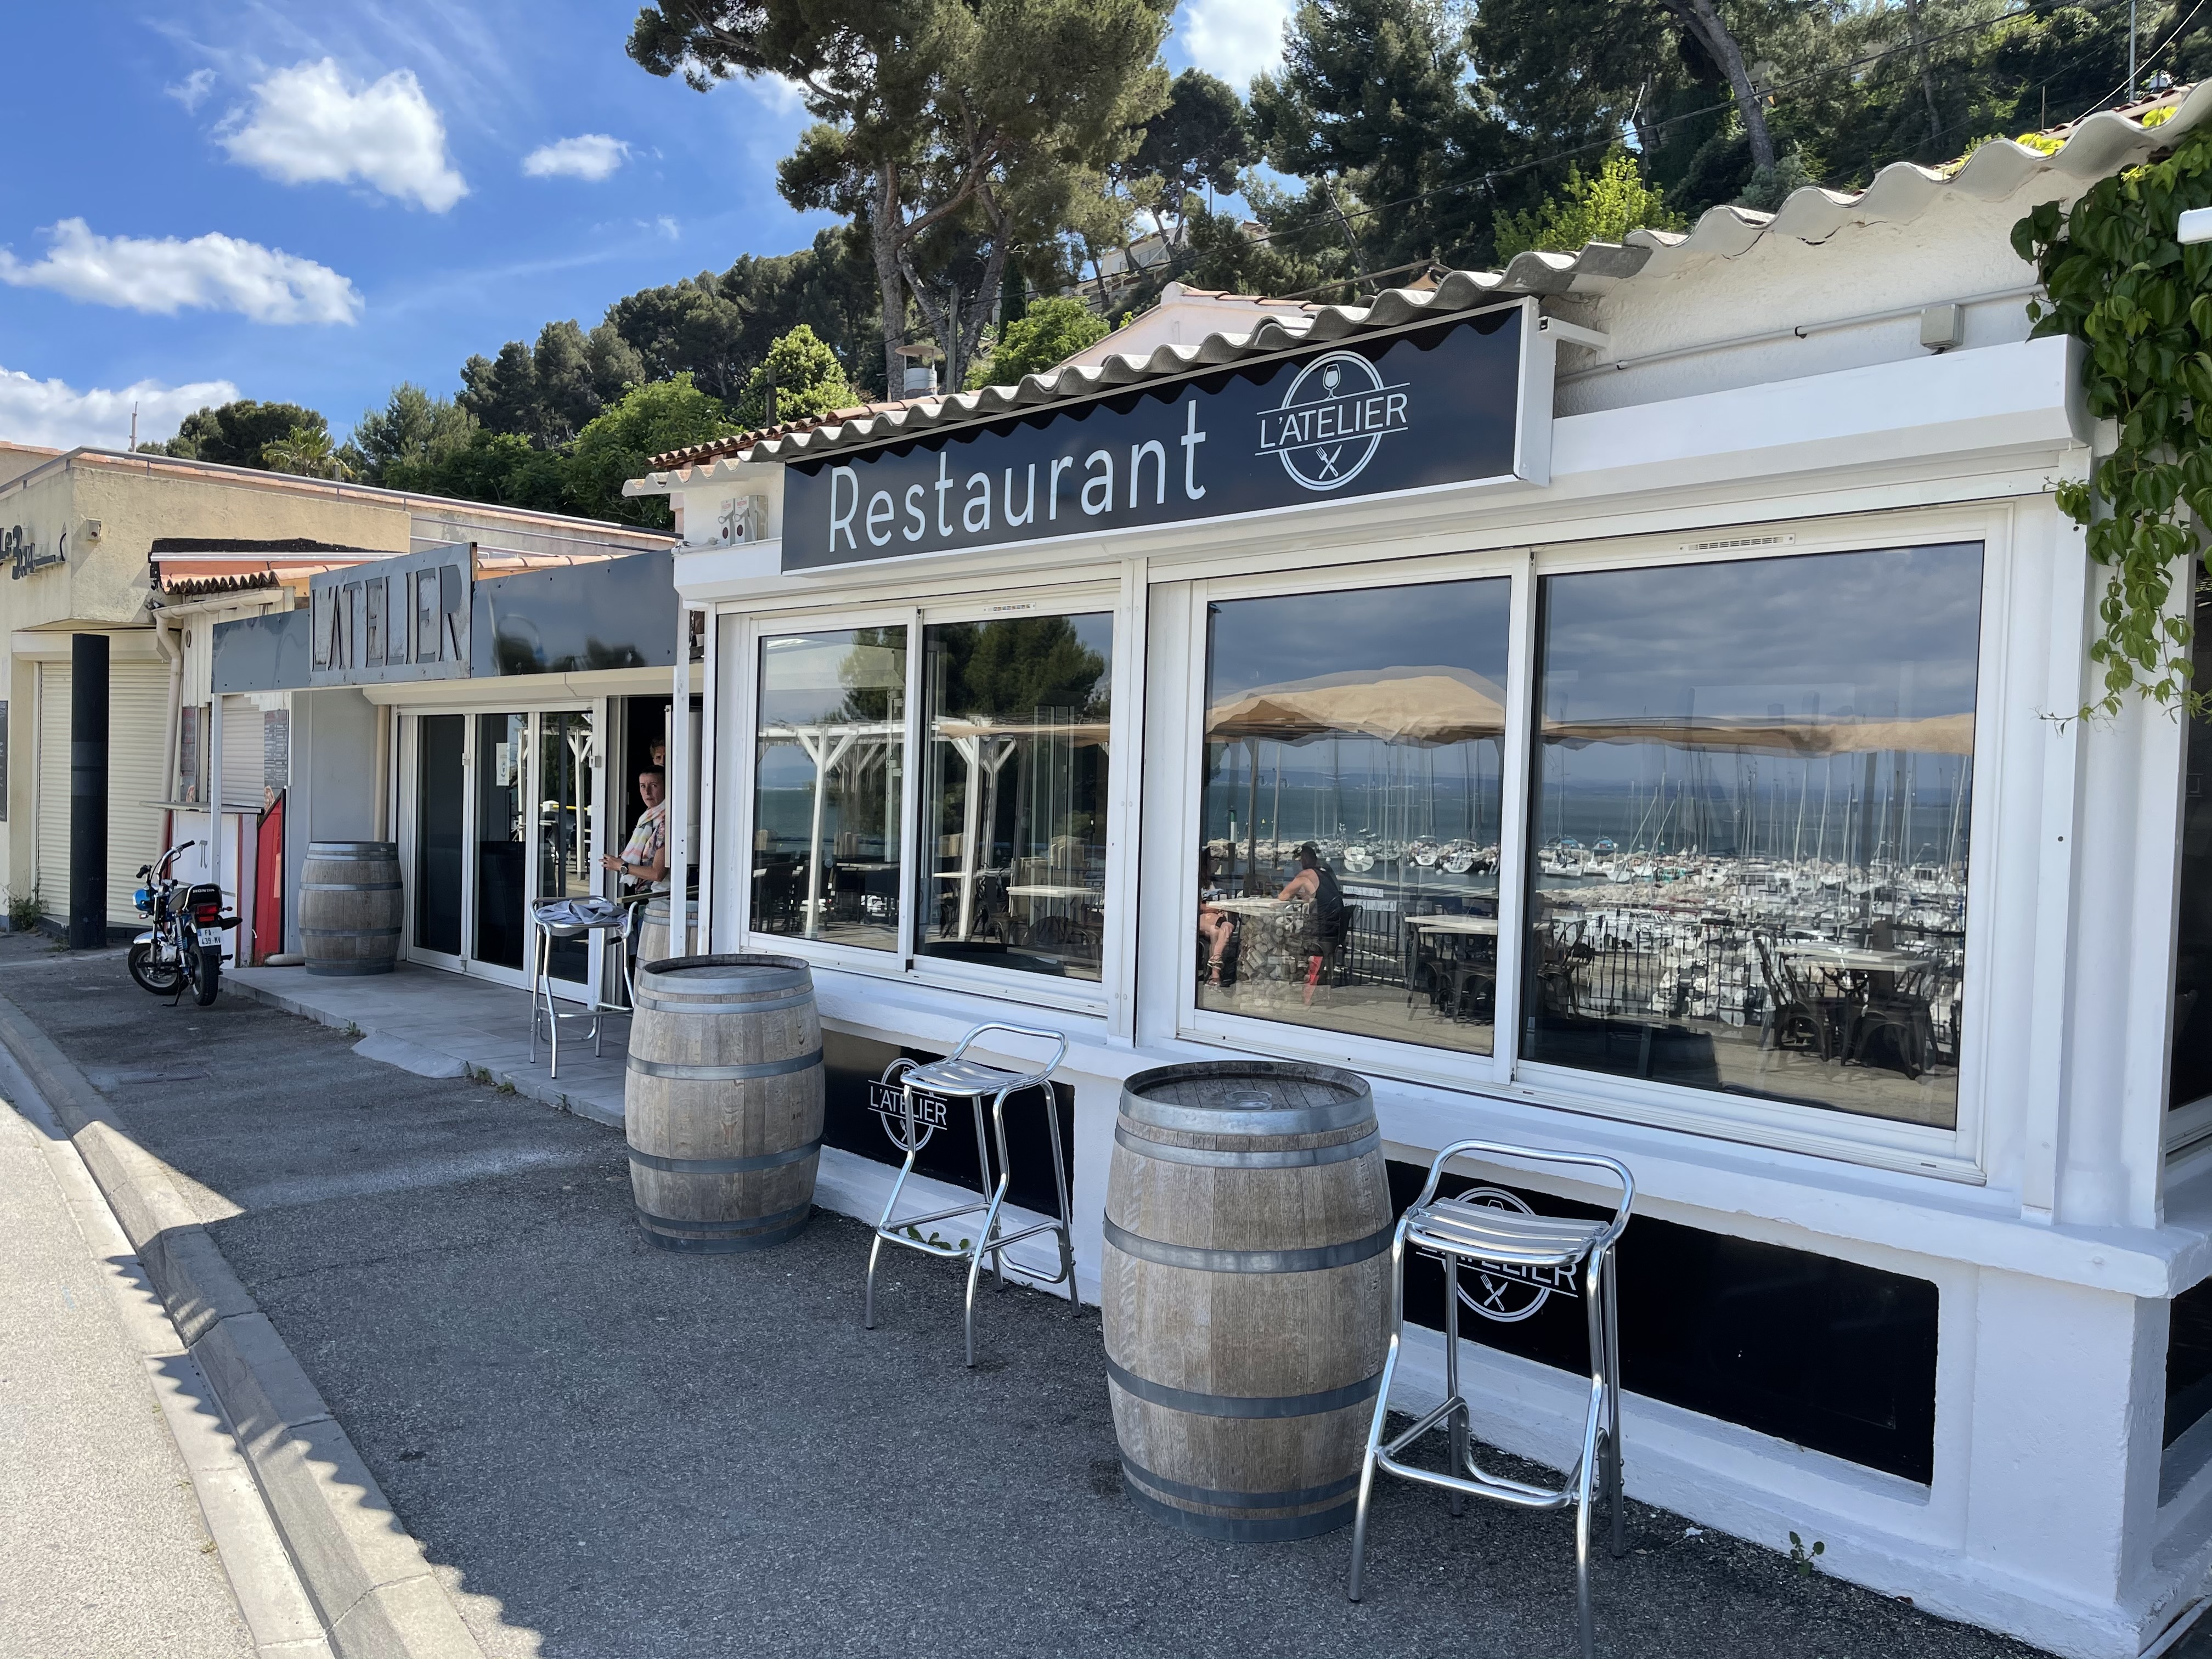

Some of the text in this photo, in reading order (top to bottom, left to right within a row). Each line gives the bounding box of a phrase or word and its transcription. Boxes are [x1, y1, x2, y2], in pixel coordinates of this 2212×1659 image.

[1261, 393, 1408, 448] L'ATELIER
[829, 400, 1206, 552] Restaurant
[312, 565, 462, 672] L'ATELIER
[871, 1086, 946, 1125] L'ATEIER
